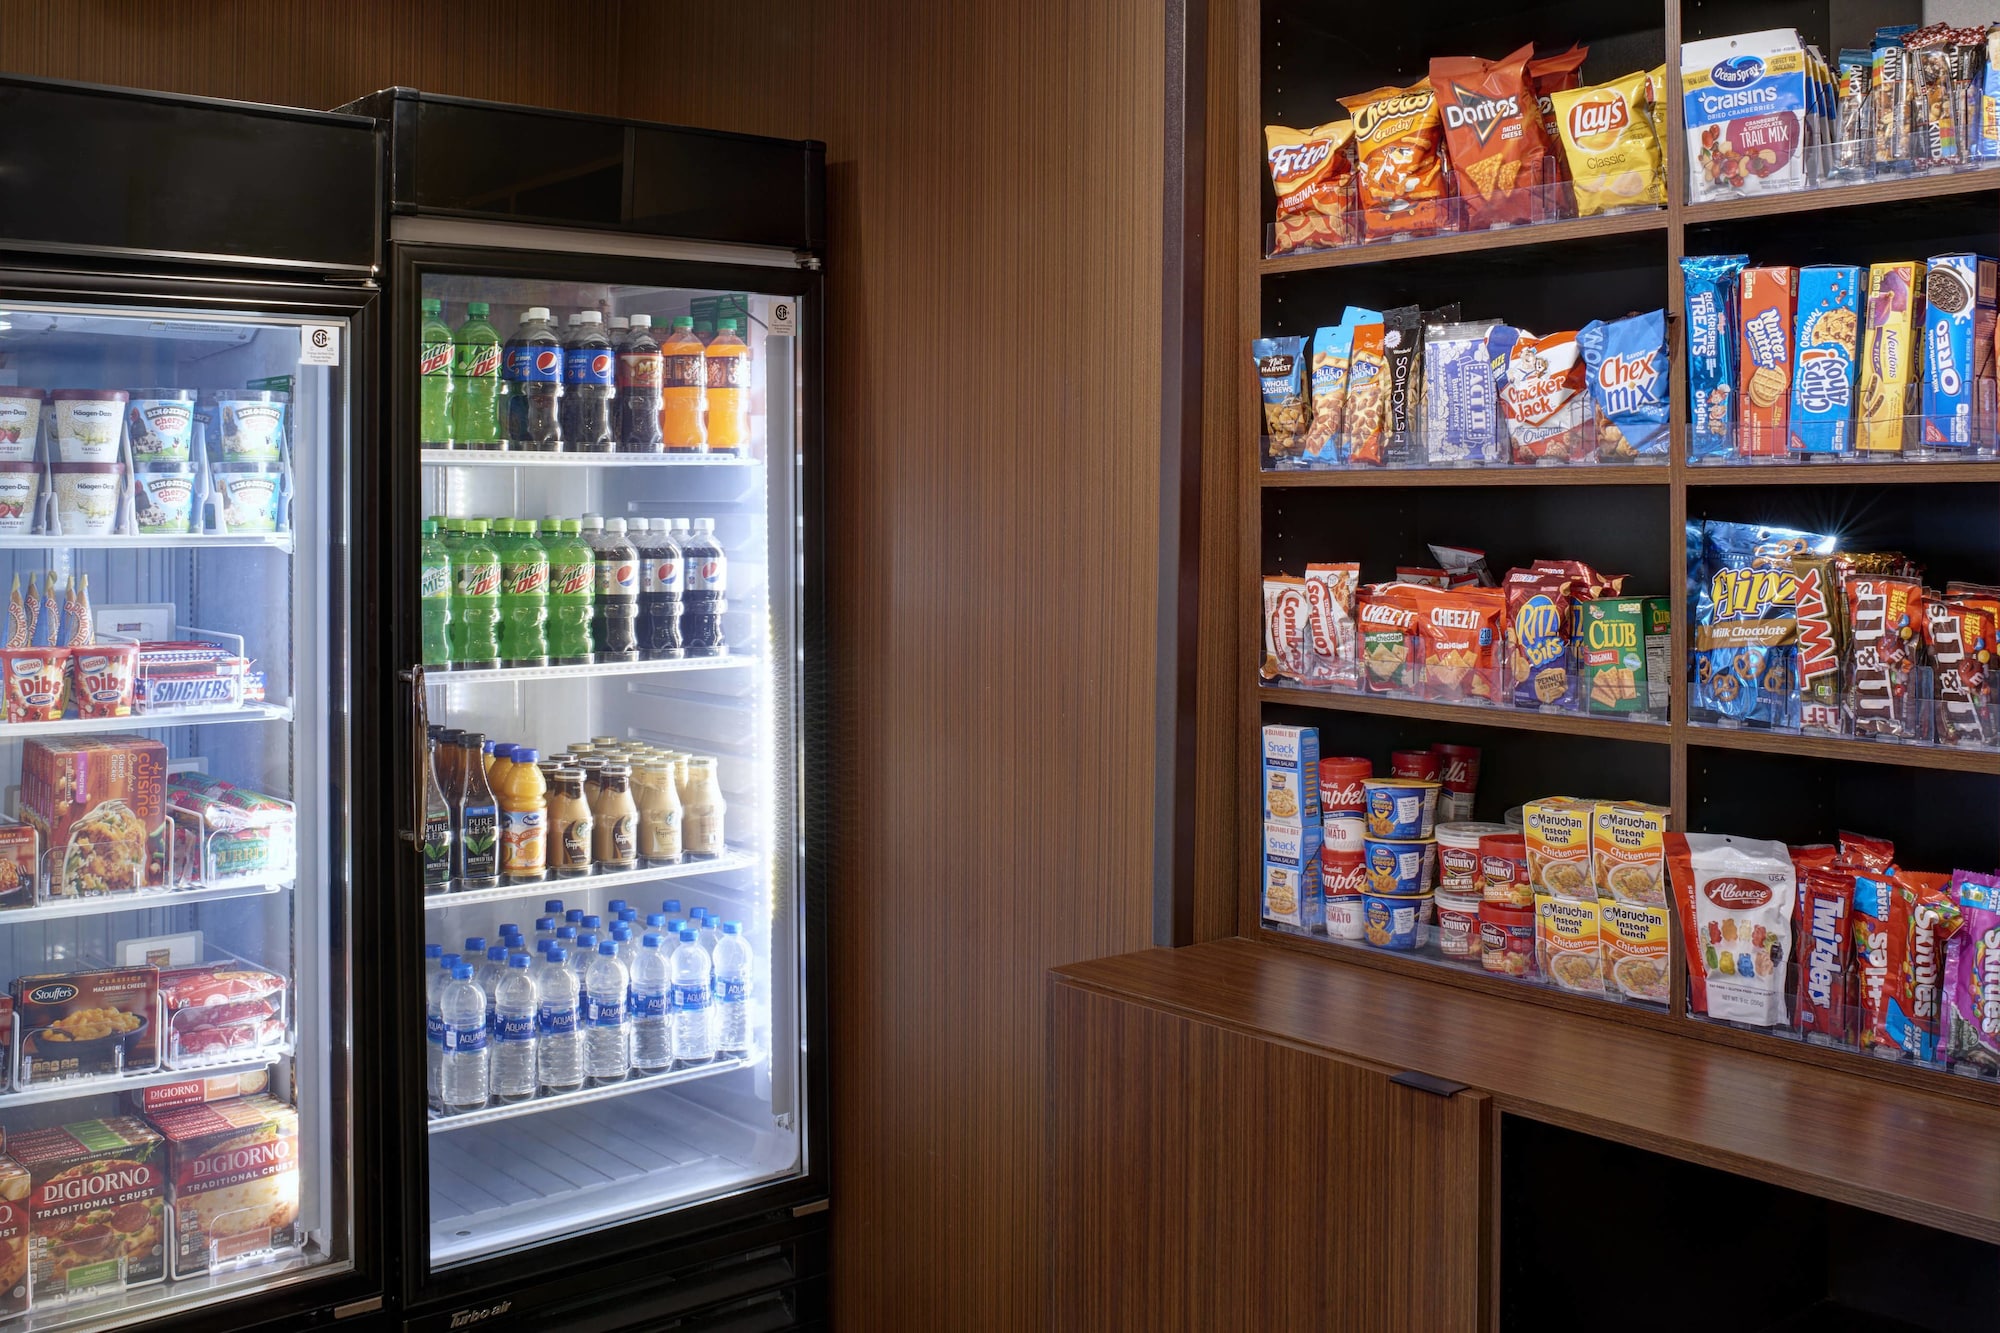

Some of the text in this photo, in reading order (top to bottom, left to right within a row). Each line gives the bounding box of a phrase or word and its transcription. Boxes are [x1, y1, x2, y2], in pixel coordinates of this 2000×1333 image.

[1714, 64, 1760, 82] Ocean Spray
[1882, 47, 1896, 82] KIND
[1704, 86, 1777, 113] Craisins
[1446, 95, 1519, 129] Doritos
[1574, 99, 1623, 138] Lay's
[1707, 104, 1775, 120] DRIED CRANBERRIES
[1745, 116, 1779, 127] CRANBERRY
[1373, 118, 1414, 142] Crunchy
[1501, 130, 1523, 140] CHEESE
[1502, 124, 1521, 133] NACHO
[1740, 125, 1789, 148] TRAIL MIX
[1748, 121, 1783, 131] CHOCOLATE
[1929, 121, 1941, 158] KIND
[1268, 139, 1332, 181] Fritos
[1587, 153, 1626, 170] Classic
[1284, 183, 1320, 207] ORIGINAL
[1691, 294, 1707, 356] TREATS
[1703, 291, 1716, 357] RICE KRISPIES
[1800, 308, 1822, 347] ORIGINAL
[1747, 319, 1774, 370] Butter
[1760, 308, 1786, 363] Nutter
[1269, 357, 1285, 368] Nut
[1886, 330, 1898, 378] Newtons
[1936, 320, 1960, 394] OREO
[1261, 365, 1291, 373] HARVEST
[1316, 368, 1334, 377] BLUE
[1600, 352, 1655, 388] Chex
[1470, 372, 1484, 406] ACT
[1508, 375, 1566, 404] Cracker
[1804, 361, 1831, 412] Chips
[1393, 356, 1409, 443] PISTACHIOS
[1516, 398, 1553, 423] Jack
[1523, 426, 1564, 443] Original
[1888, 589, 1901, 621] SHARE
[1898, 591, 1908, 612] SIZE
[1308, 584, 1332, 656] Combos
[1518, 604, 1559, 646] RITZ
[1795, 570, 1837, 690] TWIX
[1964, 612, 1976, 645] SHARE
[1972, 615, 1981, 636] SIZE
[1284, 597, 1301, 669] Combos
[1589, 621, 1637, 650] CLUB
[1712, 625, 1787, 639] Milk Chocolate
[1527, 639, 1562, 666] bits
[19, 674, 61, 696] Dibs
[86, 672, 125, 693] Dibs
[1537, 674, 1563, 686] PEANUT
[153, 679, 231, 703] SNICKERS
[1801, 705, 1840, 725] LEFT
[1268, 742, 1294, 753] Snack
[149, 776, 161, 816] Lean
[469, 818, 493, 827] PURE
[1538, 814, 1581, 828] Maruchan
[1541, 826, 1571, 836] Instant
[1610, 814, 1656, 830] Maruchan
[1545, 834, 1568, 843] Lunch
[1612, 827, 1644, 838] Instant
[1615, 835, 1640, 846] Lunch
[1269, 838, 1296, 851] Snack
[1542, 846, 1572, 857] Chicken
[1610, 847, 1643, 860] Chicken
[1282, 857, 1295, 865] SALAD
[1444, 856, 1474, 869] CHUNKY
[1483, 863, 1511, 878] CHUNKY
[1709, 882, 1768, 900] Albanese
[1877, 882, 1888, 921] SHARE
[1550, 903, 1593, 919] Maruchan
[1553, 915, 1582, 926] Instant
[1613, 907, 1661, 925] Maruchan
[1442, 918, 1470, 932] CHUNKY
[1556, 925, 1579, 934] Lunch
[1617, 920, 1649, 932] Instant
[1620, 929, 1646, 939] Lunch
[1552, 935, 1582, 947] Chicken
[1616, 940, 1650, 953] Chicken
[1914, 905, 1939, 1017] Skittles
[35, 987, 72, 1000] Stouffer's
[93, 982, 147, 993] MACARONI CHEESE
[148, 1100, 183, 1109] TRADITIONAL
[193, 1141, 290, 1177] DIGIORNO
[44, 1167, 150, 1202] DIGIORNO
[187, 1161, 295, 1194] TRADITIONAL CRUST
[37, 1188, 155, 1219] TRADITIONAL CRUST
